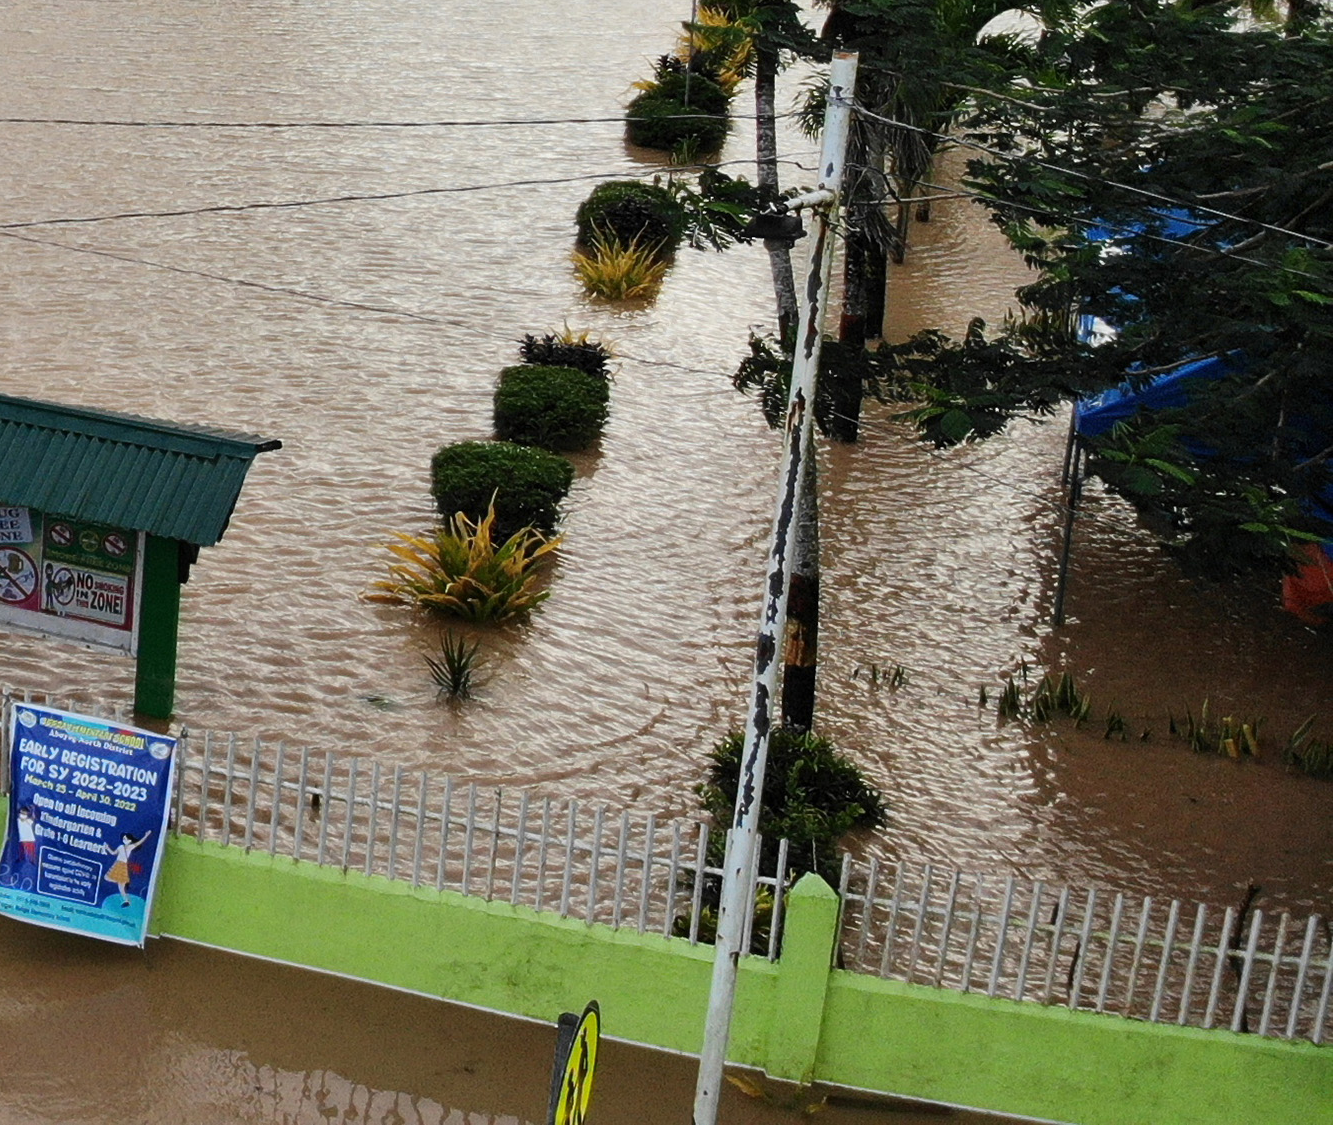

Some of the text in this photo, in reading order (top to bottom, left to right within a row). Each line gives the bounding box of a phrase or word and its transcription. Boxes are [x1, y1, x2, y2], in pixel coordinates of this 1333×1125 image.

[76, 572, 124, 595] NO SMOKING
[76, 590, 88, 599] IN
[90, 591, 124, 615] ZONE!
[103, 741, 133, 755] District
[113, 733, 145, 749] SCHOOL
[19, 738, 158, 786] EARLY REGISTRATION
[21, 756, 148, 801] FOR SY 2022-2023
[24, 774, 54, 790] March
[75, 788, 98, 803] April
[114, 798, 137, 812] 2022
[33, 793, 117, 827] Open to all Incoming
[35, 823, 55, 839] Grade
[57, 831, 69, 844] 1-6
[40, 811, 102, 838] Kindergarten &
